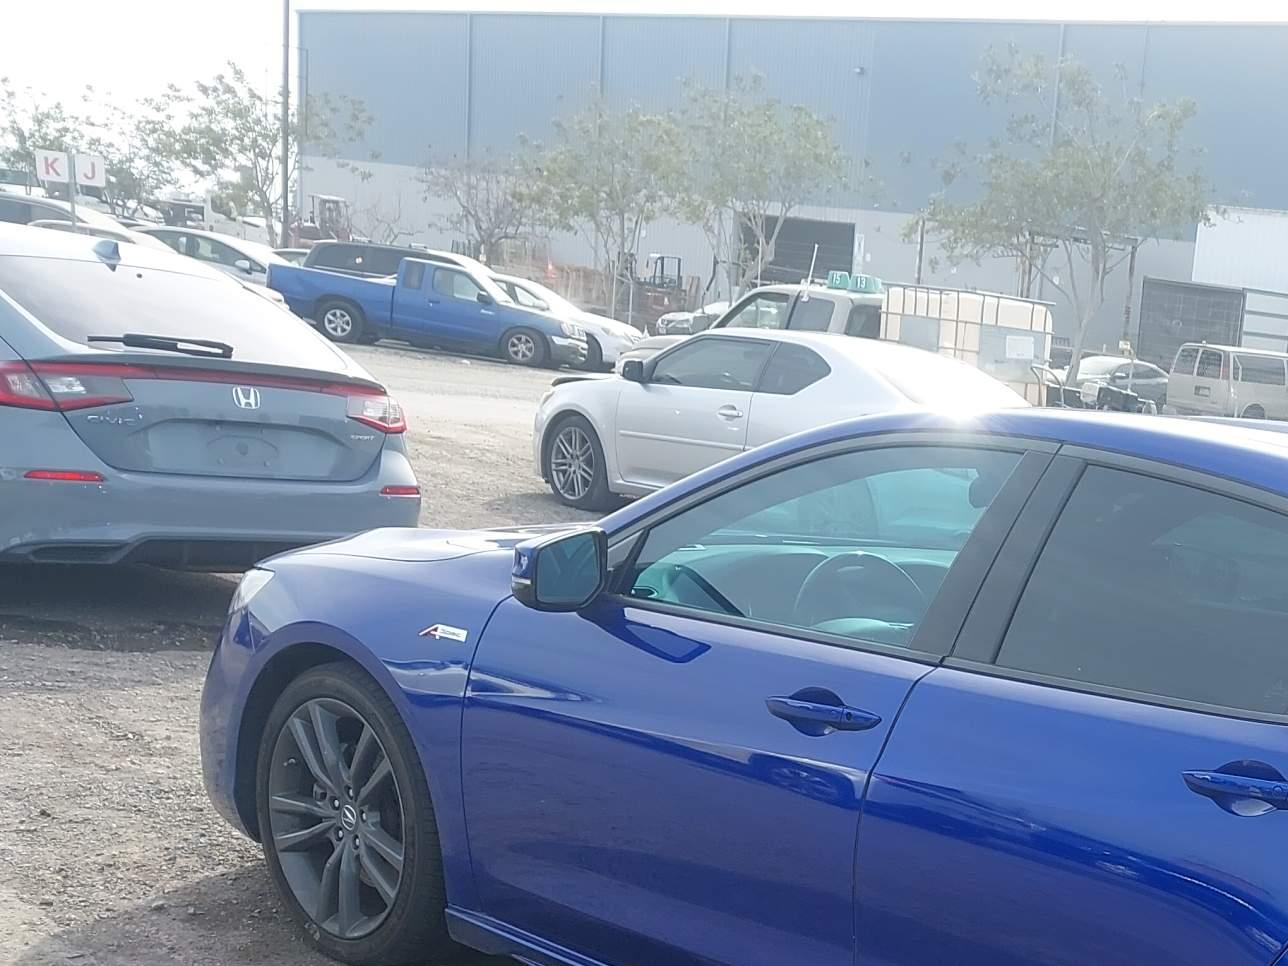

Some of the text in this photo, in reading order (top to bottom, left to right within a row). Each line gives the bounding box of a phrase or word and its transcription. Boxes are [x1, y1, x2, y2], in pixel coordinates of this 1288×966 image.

[43, 156, 61, 177] K
[82, 161, 96, 180] J
[856, 276, 866, 289] 13
